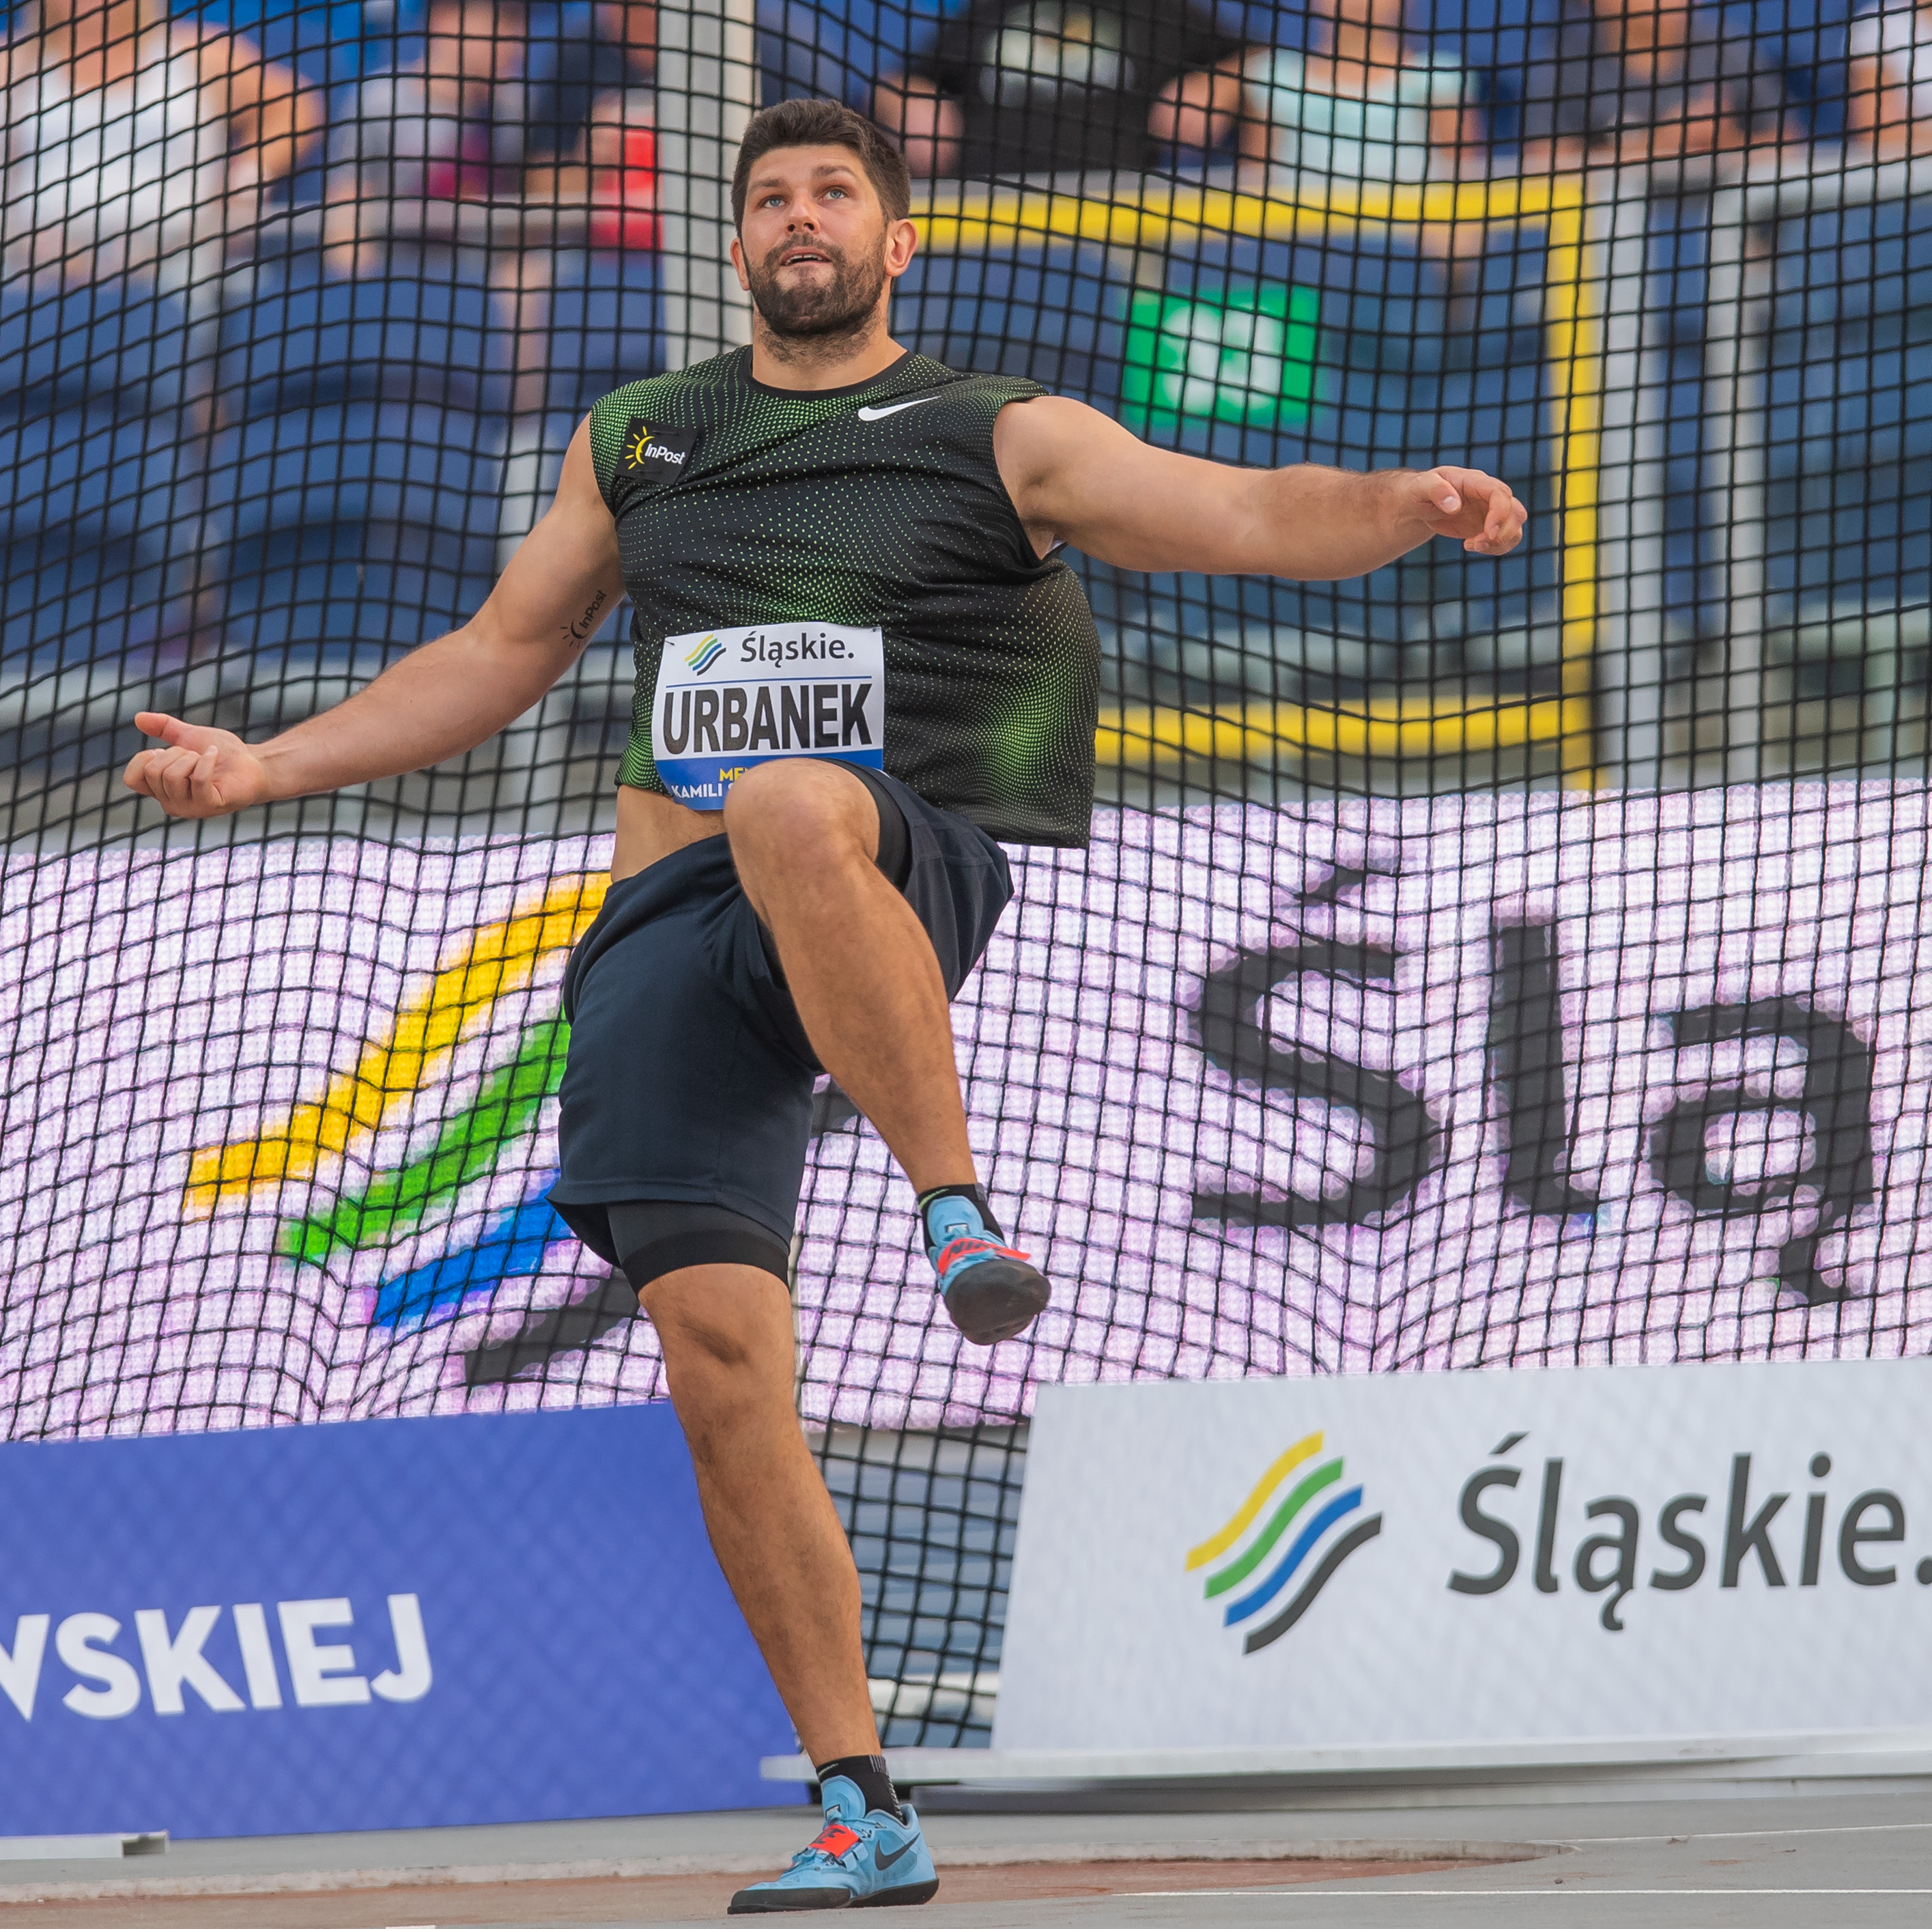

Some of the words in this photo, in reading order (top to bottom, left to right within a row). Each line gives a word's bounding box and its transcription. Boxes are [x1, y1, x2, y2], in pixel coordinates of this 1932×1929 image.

[644, 443, 685, 465] InPost
[579, 589, 607, 630] InPost
[740, 630, 855, 668] Śląskie.
[663, 683, 872, 755] URBANEK
[719, 767, 749, 782] ME
[671, 783, 723, 798] KAMILI
